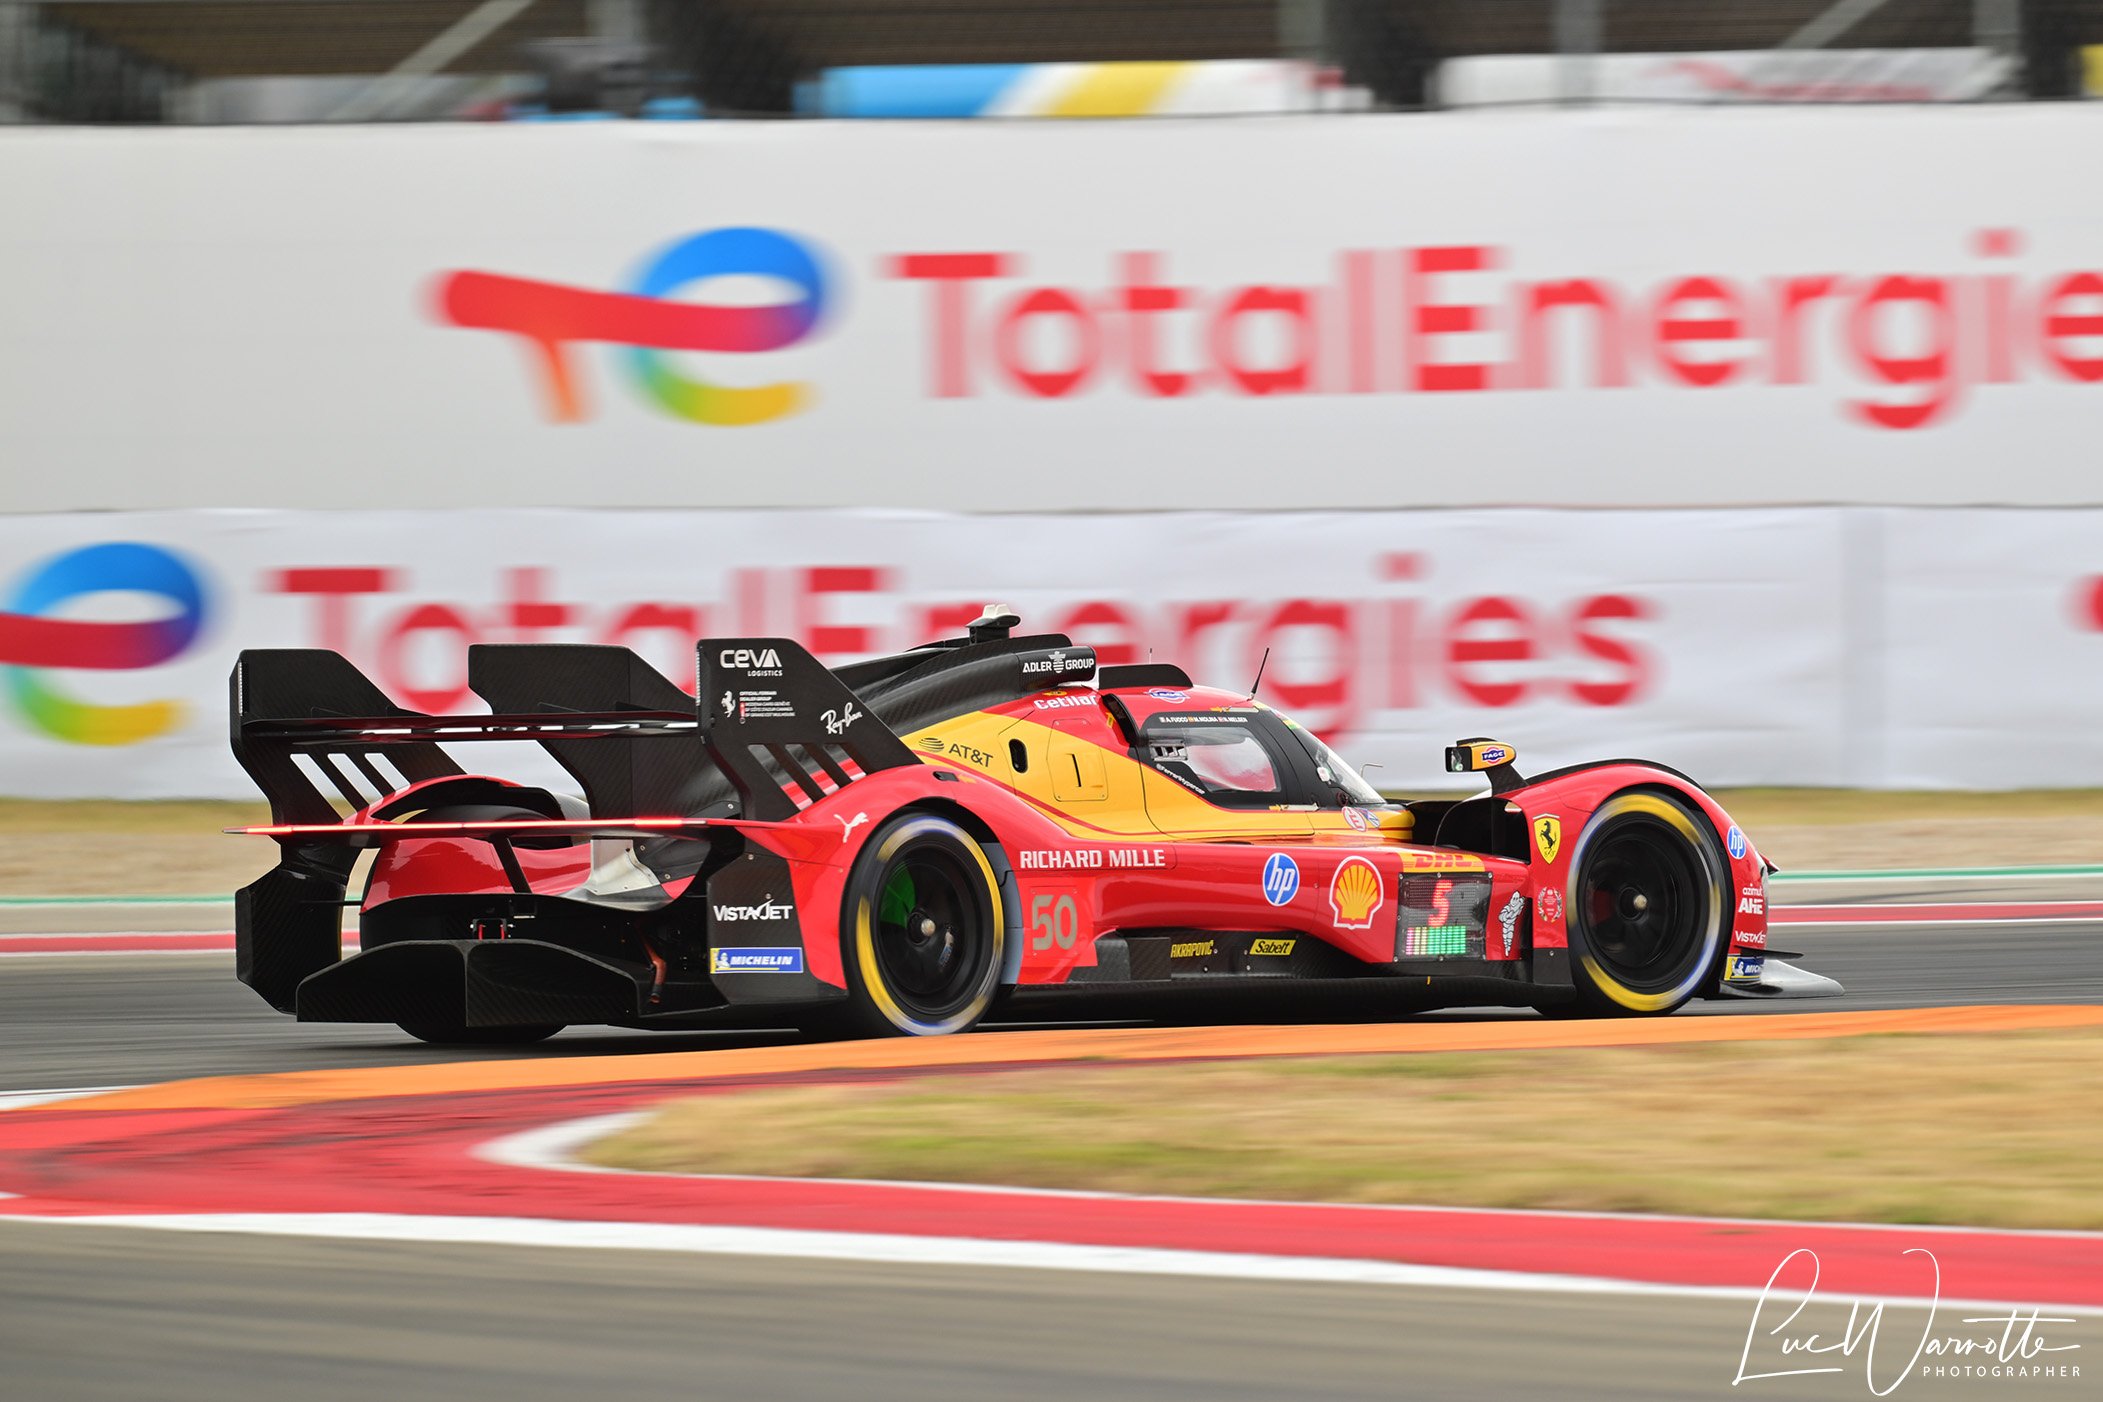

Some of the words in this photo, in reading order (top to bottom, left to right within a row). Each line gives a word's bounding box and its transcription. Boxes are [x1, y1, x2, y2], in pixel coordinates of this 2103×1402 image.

[1022, 661, 1052, 673] ADLER
[1065, 658, 1095, 670] GROUP
[1033, 695, 1099, 710] Cetilar
[820, 702, 863, 735] Ray-Ban
[948, 743, 994, 768] AT&T
[1730, 827, 1744, 858] hp
[1020, 850, 1103, 869] RICHARD
[1109, 849, 1167, 868] MILLE
[1412, 853, 1474, 868] DHL
[1267, 854, 1296, 905] hp
[1427, 879, 1454, 929] 5
[1032, 894, 1078, 951] 50
[730, 955, 793, 965] MICHELIN
